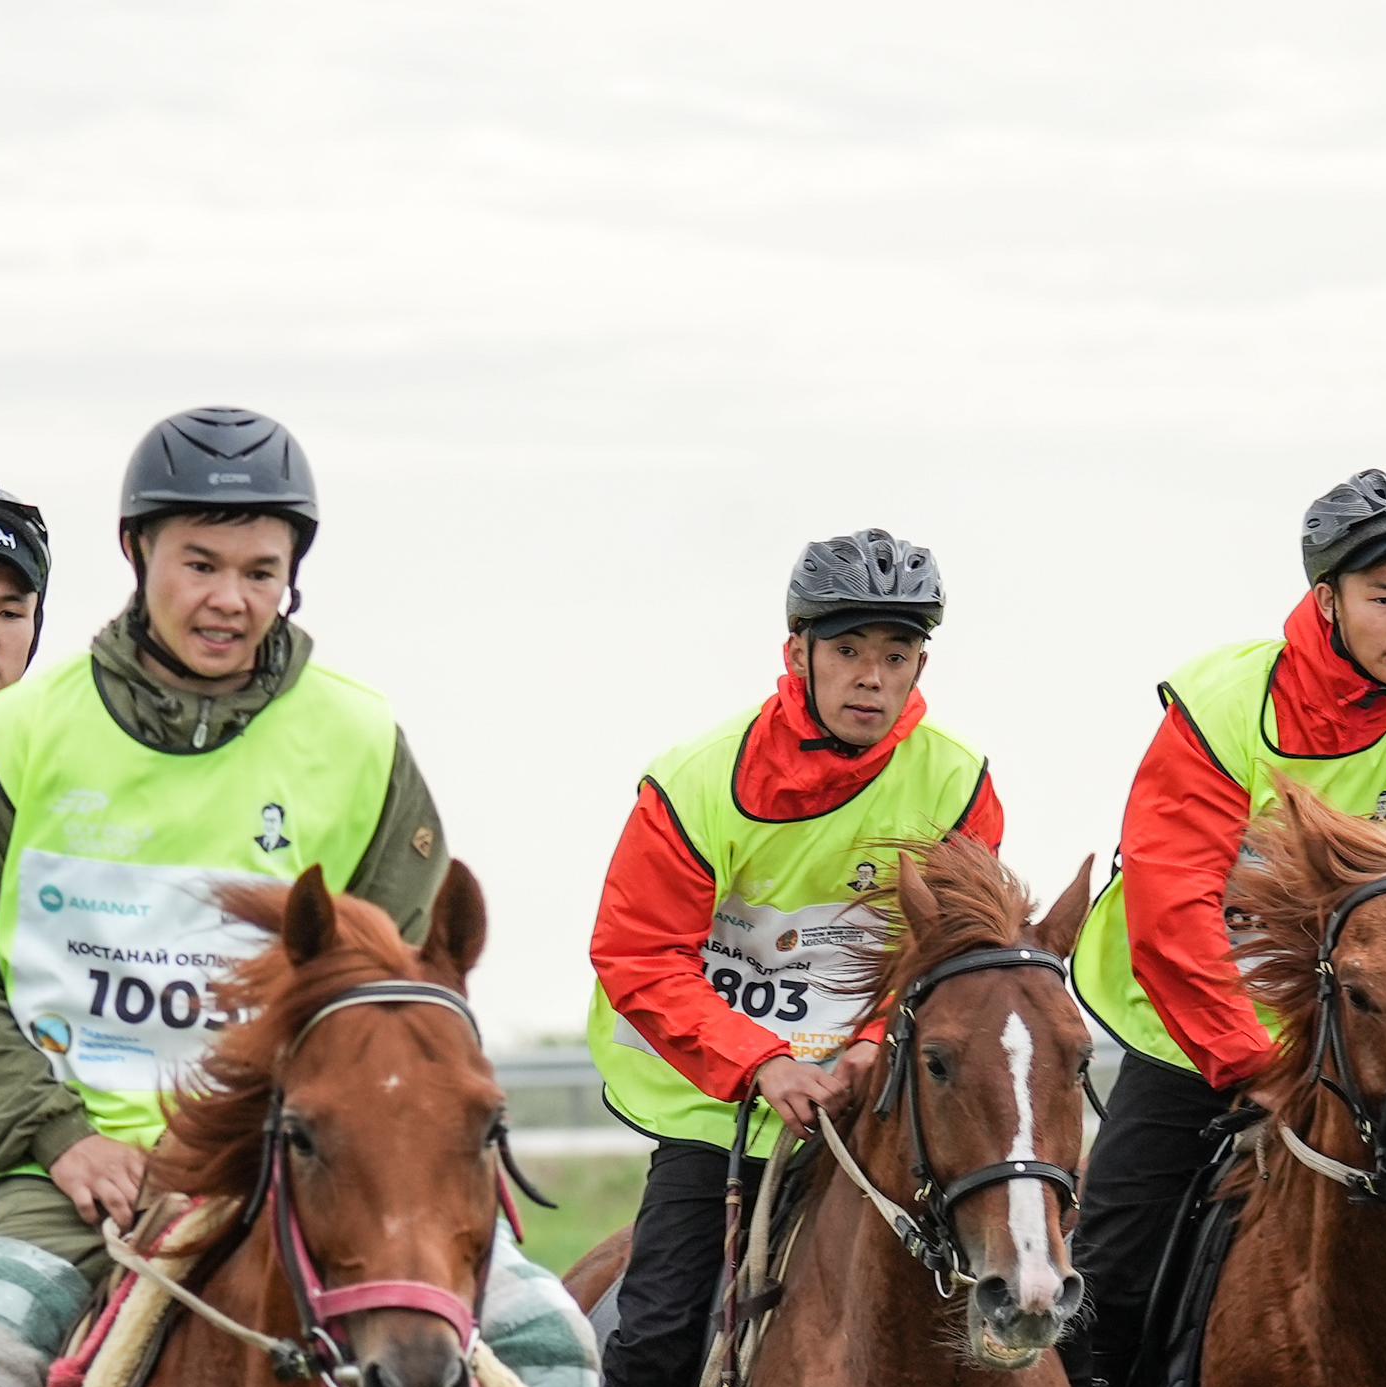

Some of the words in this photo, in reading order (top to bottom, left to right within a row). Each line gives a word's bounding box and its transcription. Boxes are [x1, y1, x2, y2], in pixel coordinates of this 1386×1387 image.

[69, 896, 151, 918] AMANAT
[715, 912, 755, 932] ANAT
[746, 956, 811, 976] ОБЛСЫ
[702, 962, 809, 1021] 803
